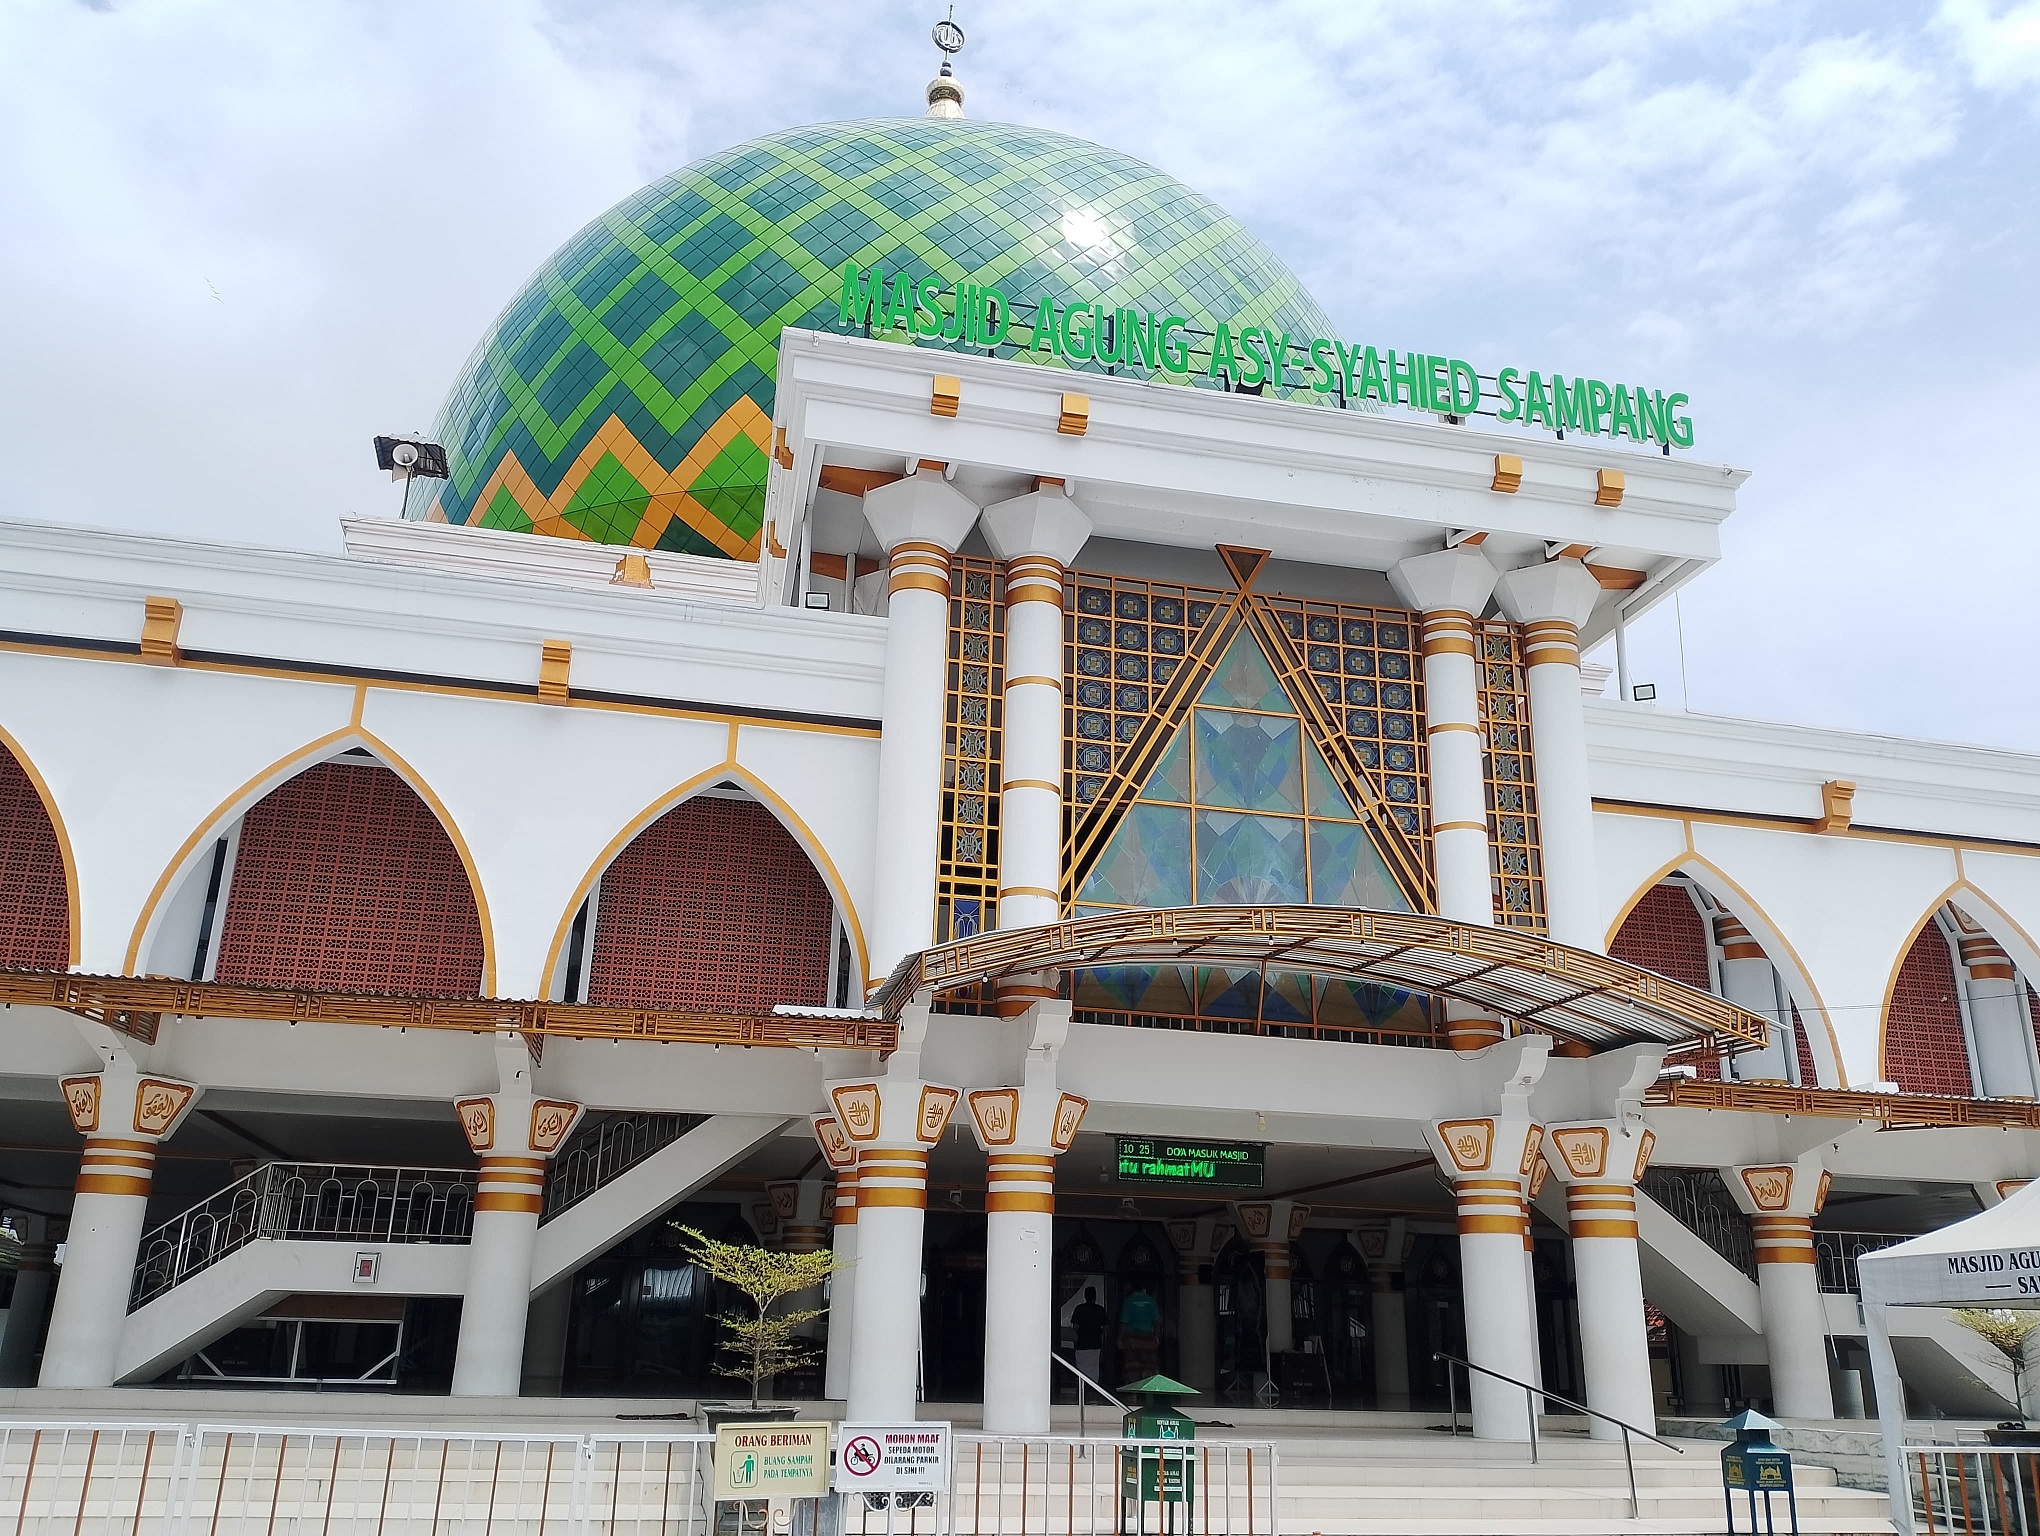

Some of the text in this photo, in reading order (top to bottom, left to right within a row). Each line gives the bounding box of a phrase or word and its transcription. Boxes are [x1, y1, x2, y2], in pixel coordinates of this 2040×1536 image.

[838, 263, 1695, 449] MASJID AGUNG ASY-SYAHIED SAMPANG
[1188, 1148, 1219, 1159] MASUK
[1220, 1150, 1249, 1161] MASJID
[1947, 1254, 2004, 1274] MASJID
[2017, 1275, 2040, 1294] SA
[735, 1434, 812, 1447] ORANG BERIMAN
[885, 1433, 940, 1444] MOHON MAAF
[888, 1446, 935, 1455] SEPEDA MOTOR
[764, 1455, 813, 1466] BUANG SAMPAH
[884, 1456, 940, 1465] DILARANG PARKIR
[763, 1468, 813, 1478] PADA TEMPATNYA
[895, 1466, 903, 1475] DI
[904, 1466, 917, 1475] SINI
